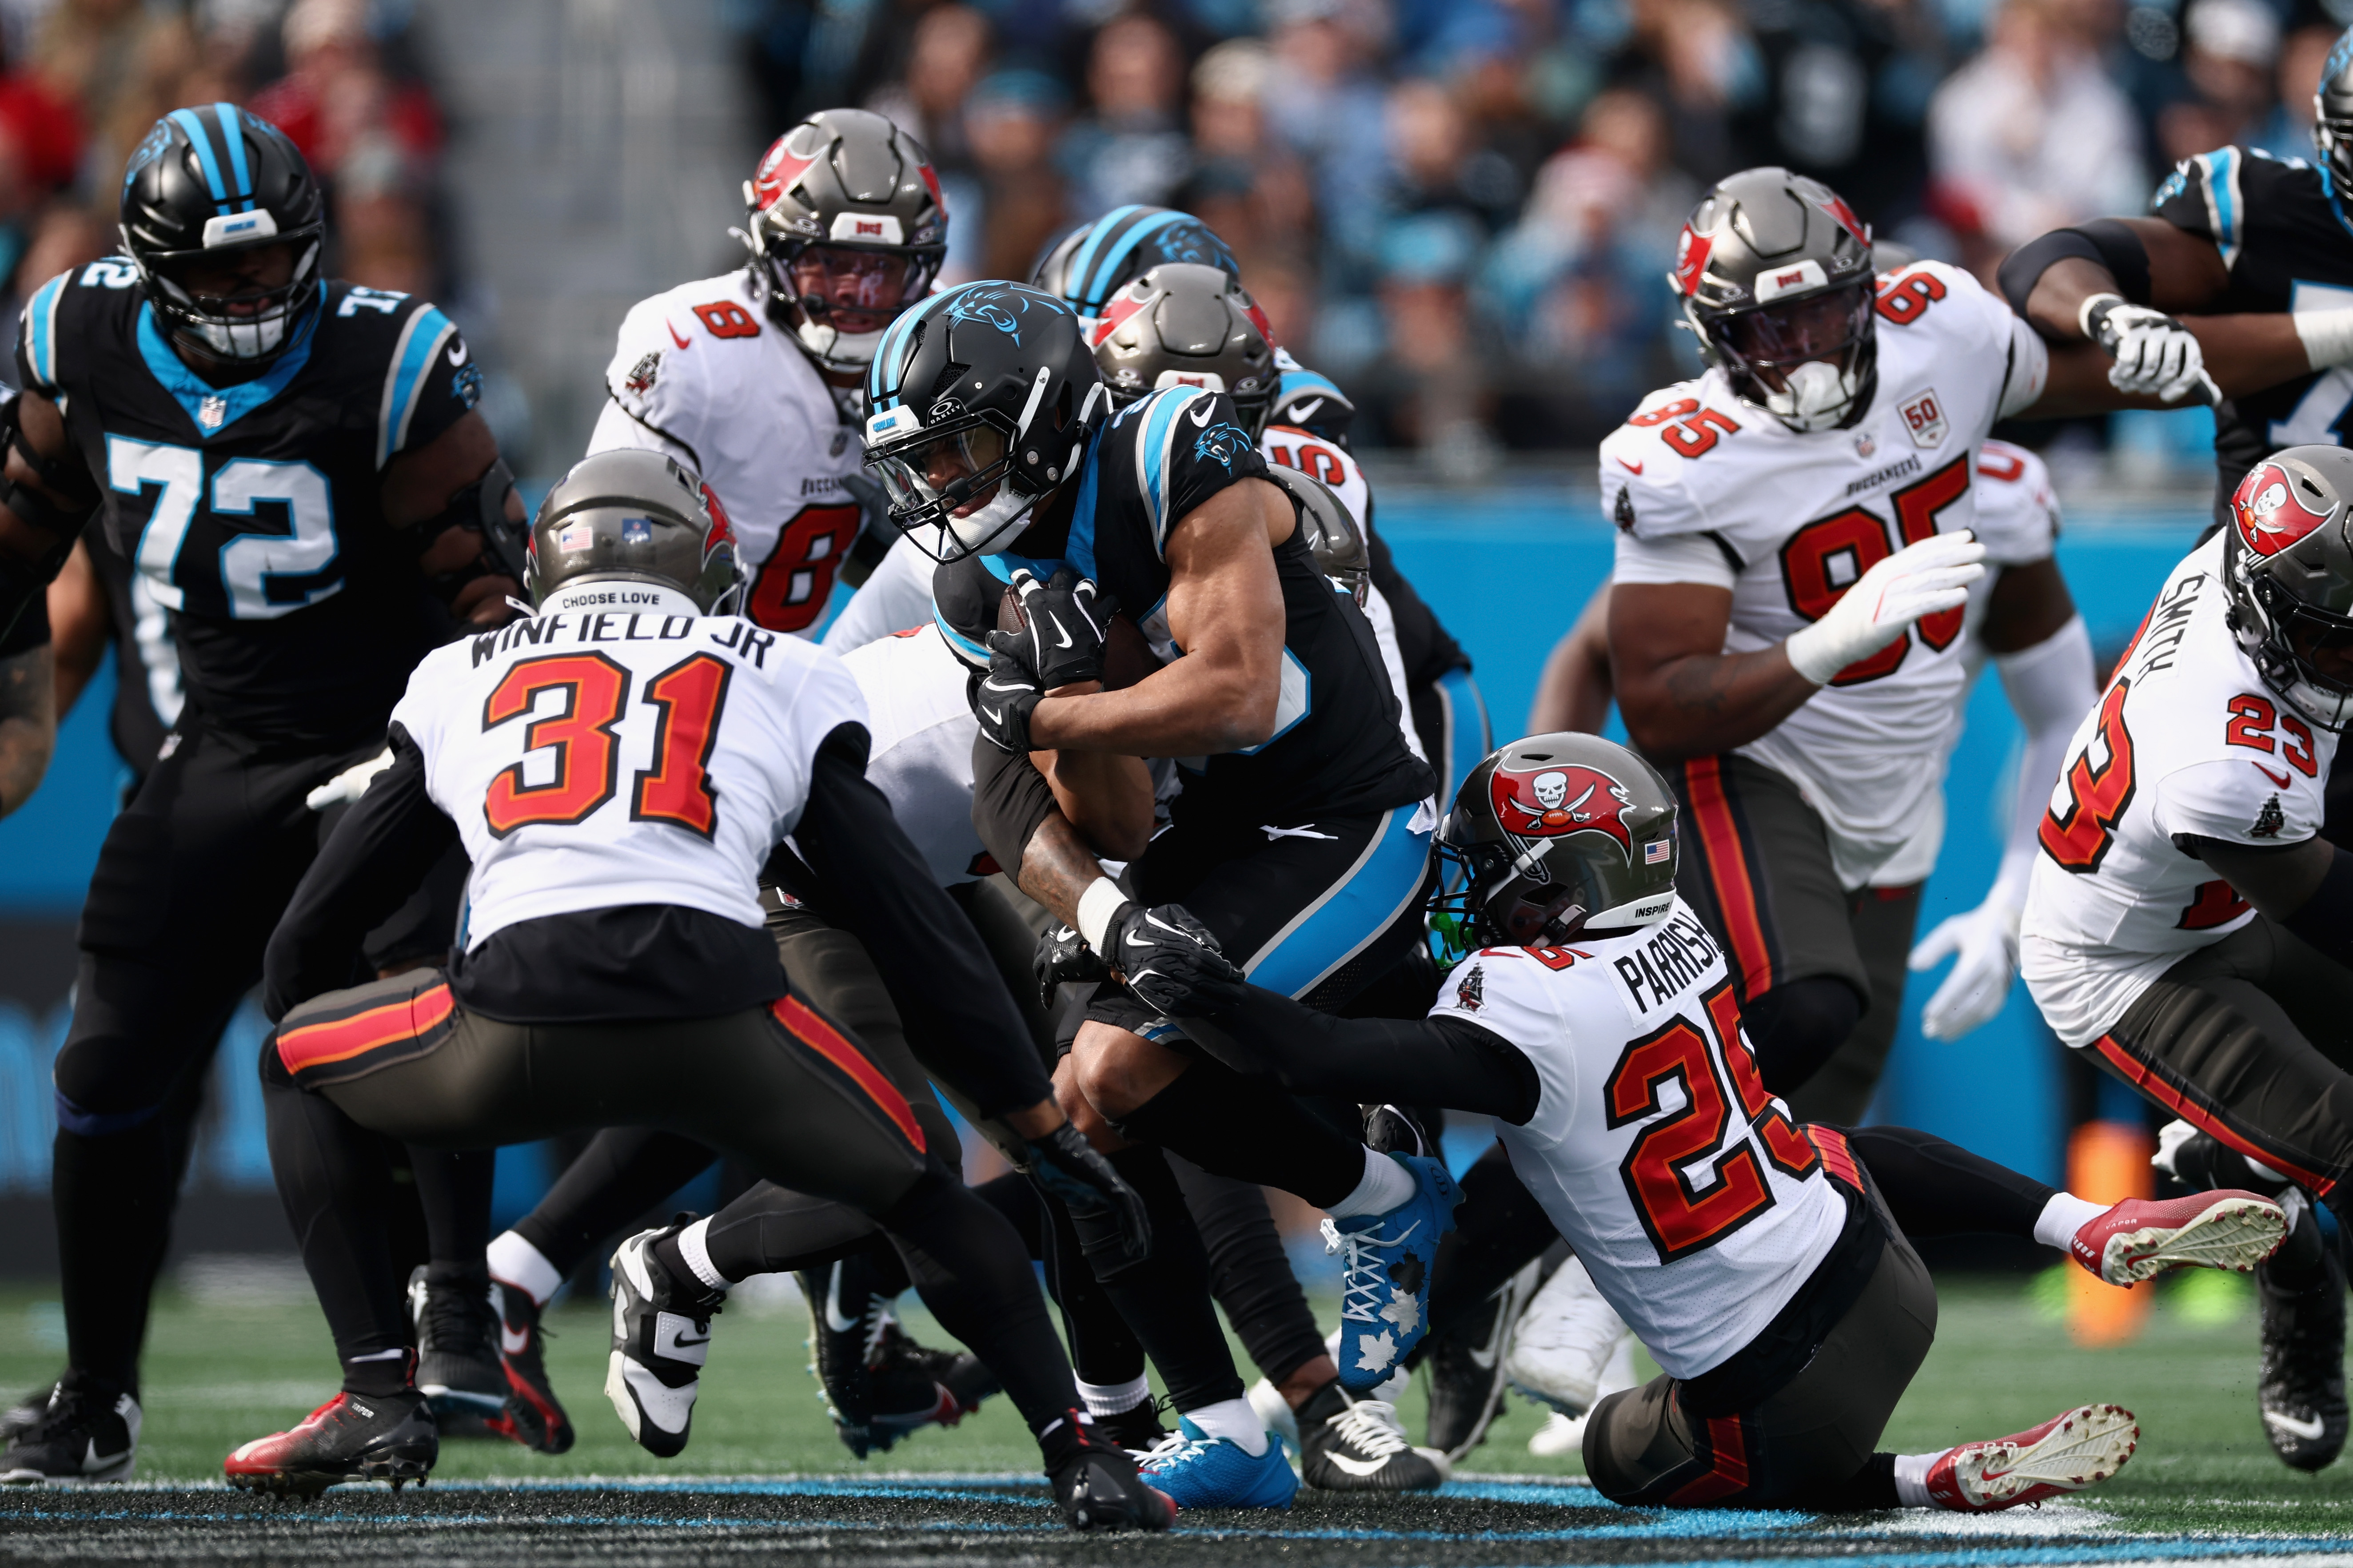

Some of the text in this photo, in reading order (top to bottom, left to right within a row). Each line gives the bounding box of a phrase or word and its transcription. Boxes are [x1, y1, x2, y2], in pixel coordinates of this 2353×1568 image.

[930, 404, 960, 424] OAKLEY
[1905, 398, 1938, 431] 50
[104, 432, 345, 620] 72
[745, 502, 862, 633] 8
[472, 614, 776, 669] WINFIELD JR
[562, 592, 660, 609] CHOOSE LOVE
[2134, 574, 2205, 688] SMITH
[482, 649, 734, 844] 31
[2038, 635, 2148, 874] 3
[2226, 693, 2317, 778] 23
[1635, 902, 1670, 918] INSPIRE
[1613, 911, 1722, 1014] PARRISH
[1603, 973, 1821, 1265] 25
[2106, 1218, 2137, 1230] VAPOR
